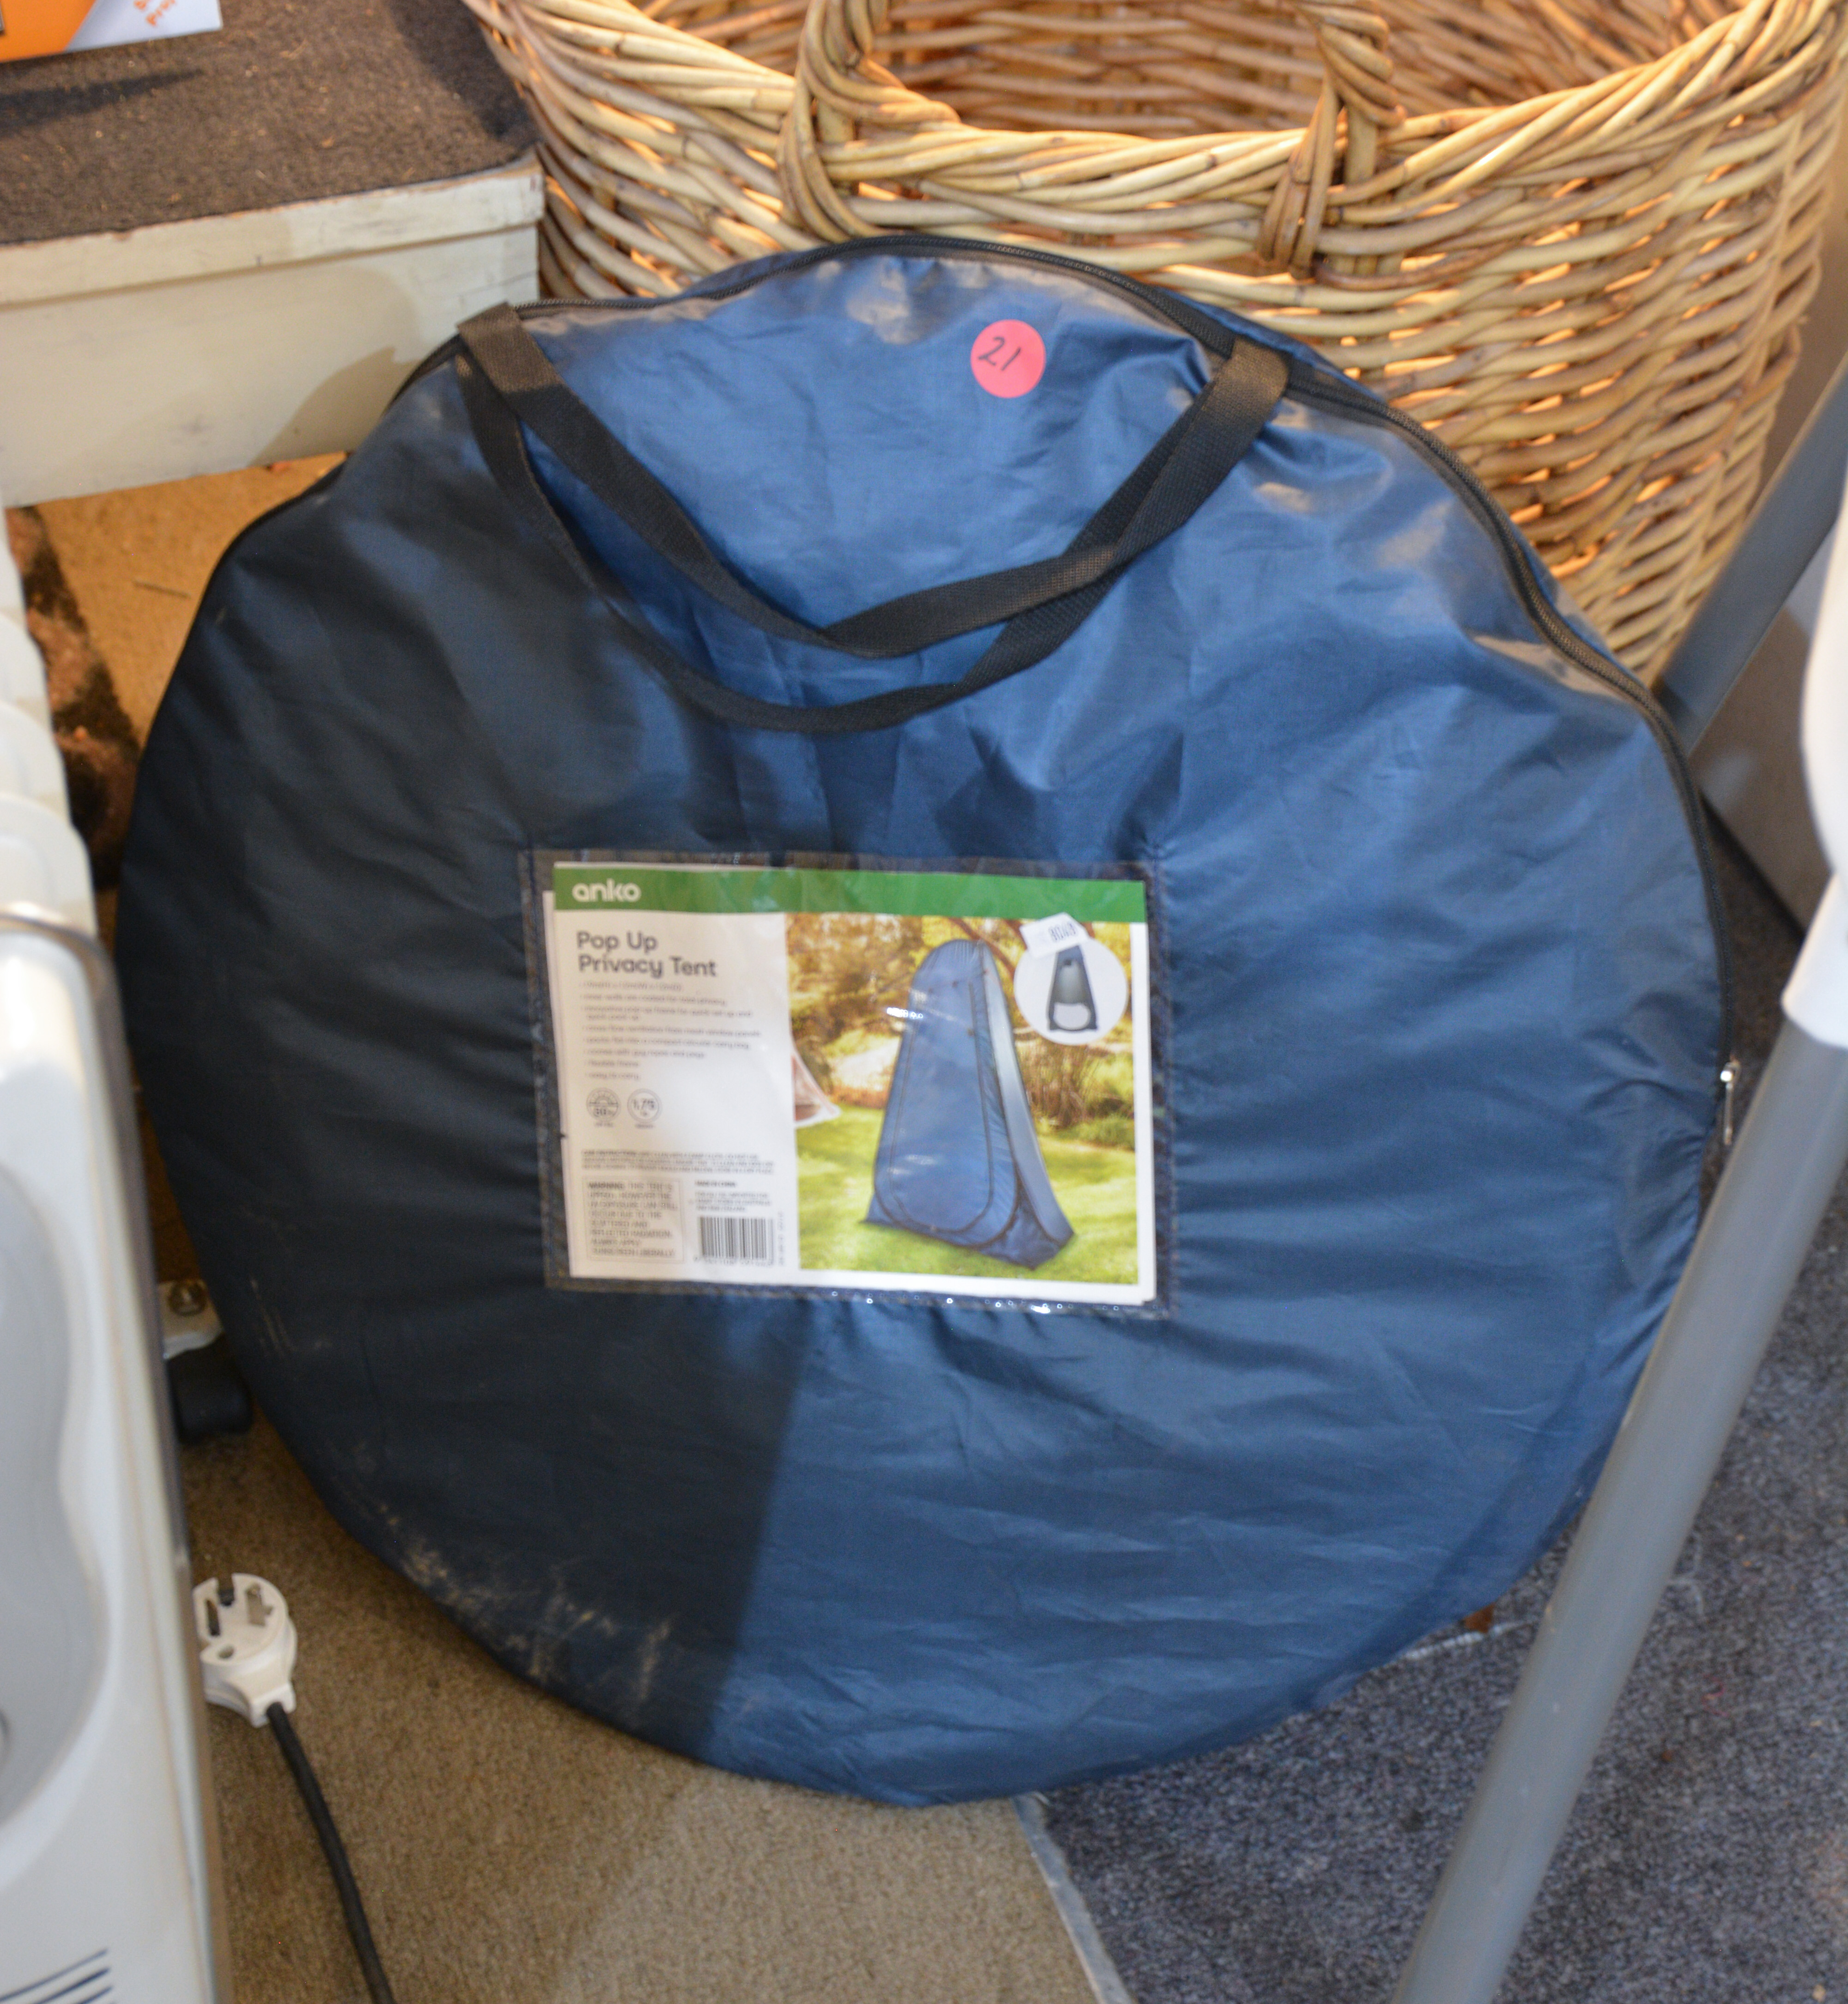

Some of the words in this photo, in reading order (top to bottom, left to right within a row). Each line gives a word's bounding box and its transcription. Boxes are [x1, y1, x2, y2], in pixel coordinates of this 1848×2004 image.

[978, 335, 1021, 372] 21
[572, 878, 641, 901] anko
[577, 931, 620, 953] Pop
[626, 930, 658, 954] Up
[579, 953, 663, 979] Privacy
[669, 956, 718, 977] Tent
